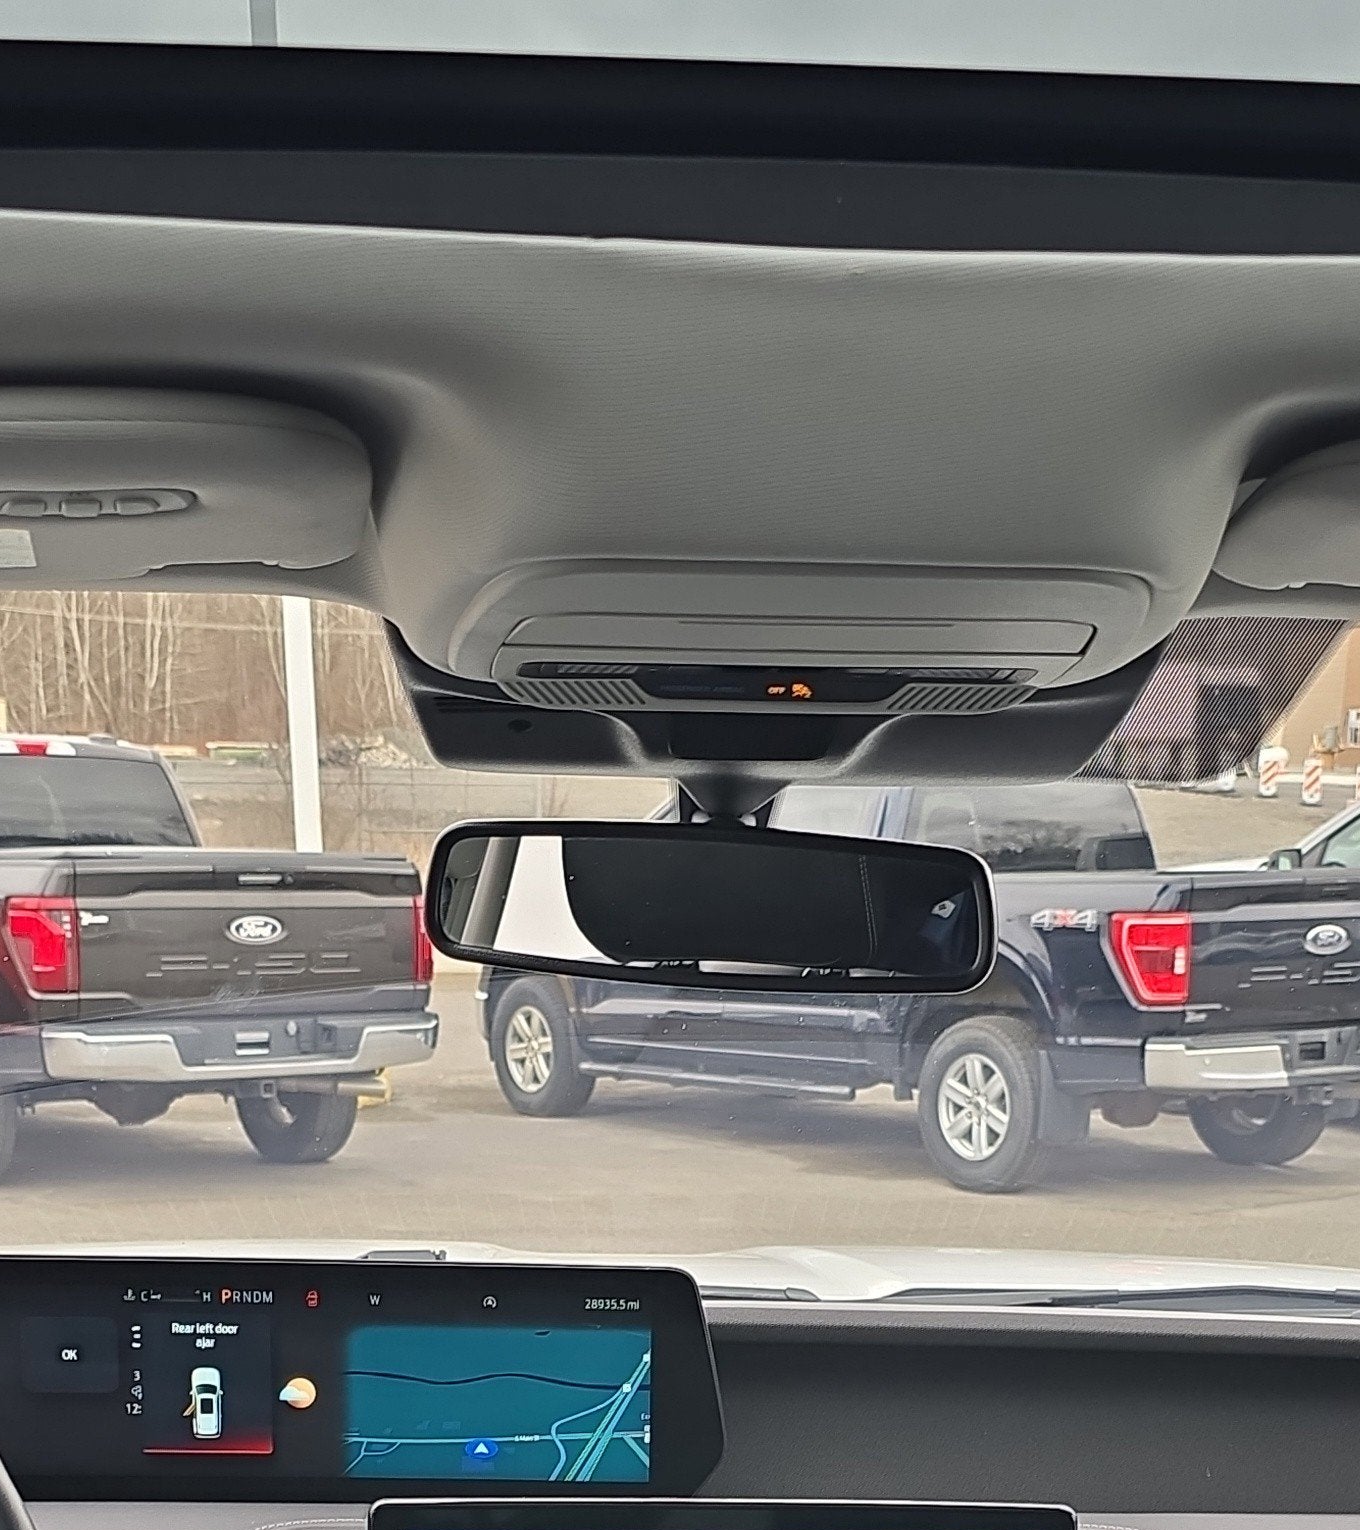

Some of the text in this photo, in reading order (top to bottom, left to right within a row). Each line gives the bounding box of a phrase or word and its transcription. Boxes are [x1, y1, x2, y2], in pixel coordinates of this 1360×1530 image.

[146, 952, 362, 976] F-150
[369, 1294, 381, 1305] W
[585, 1298, 640, 1311] 28935.5 mi
[171, 1322, 239, 1335] Rear left door
[195, 1336, 215, 1349] ajar
[61, 1349, 78, 1361] OK
